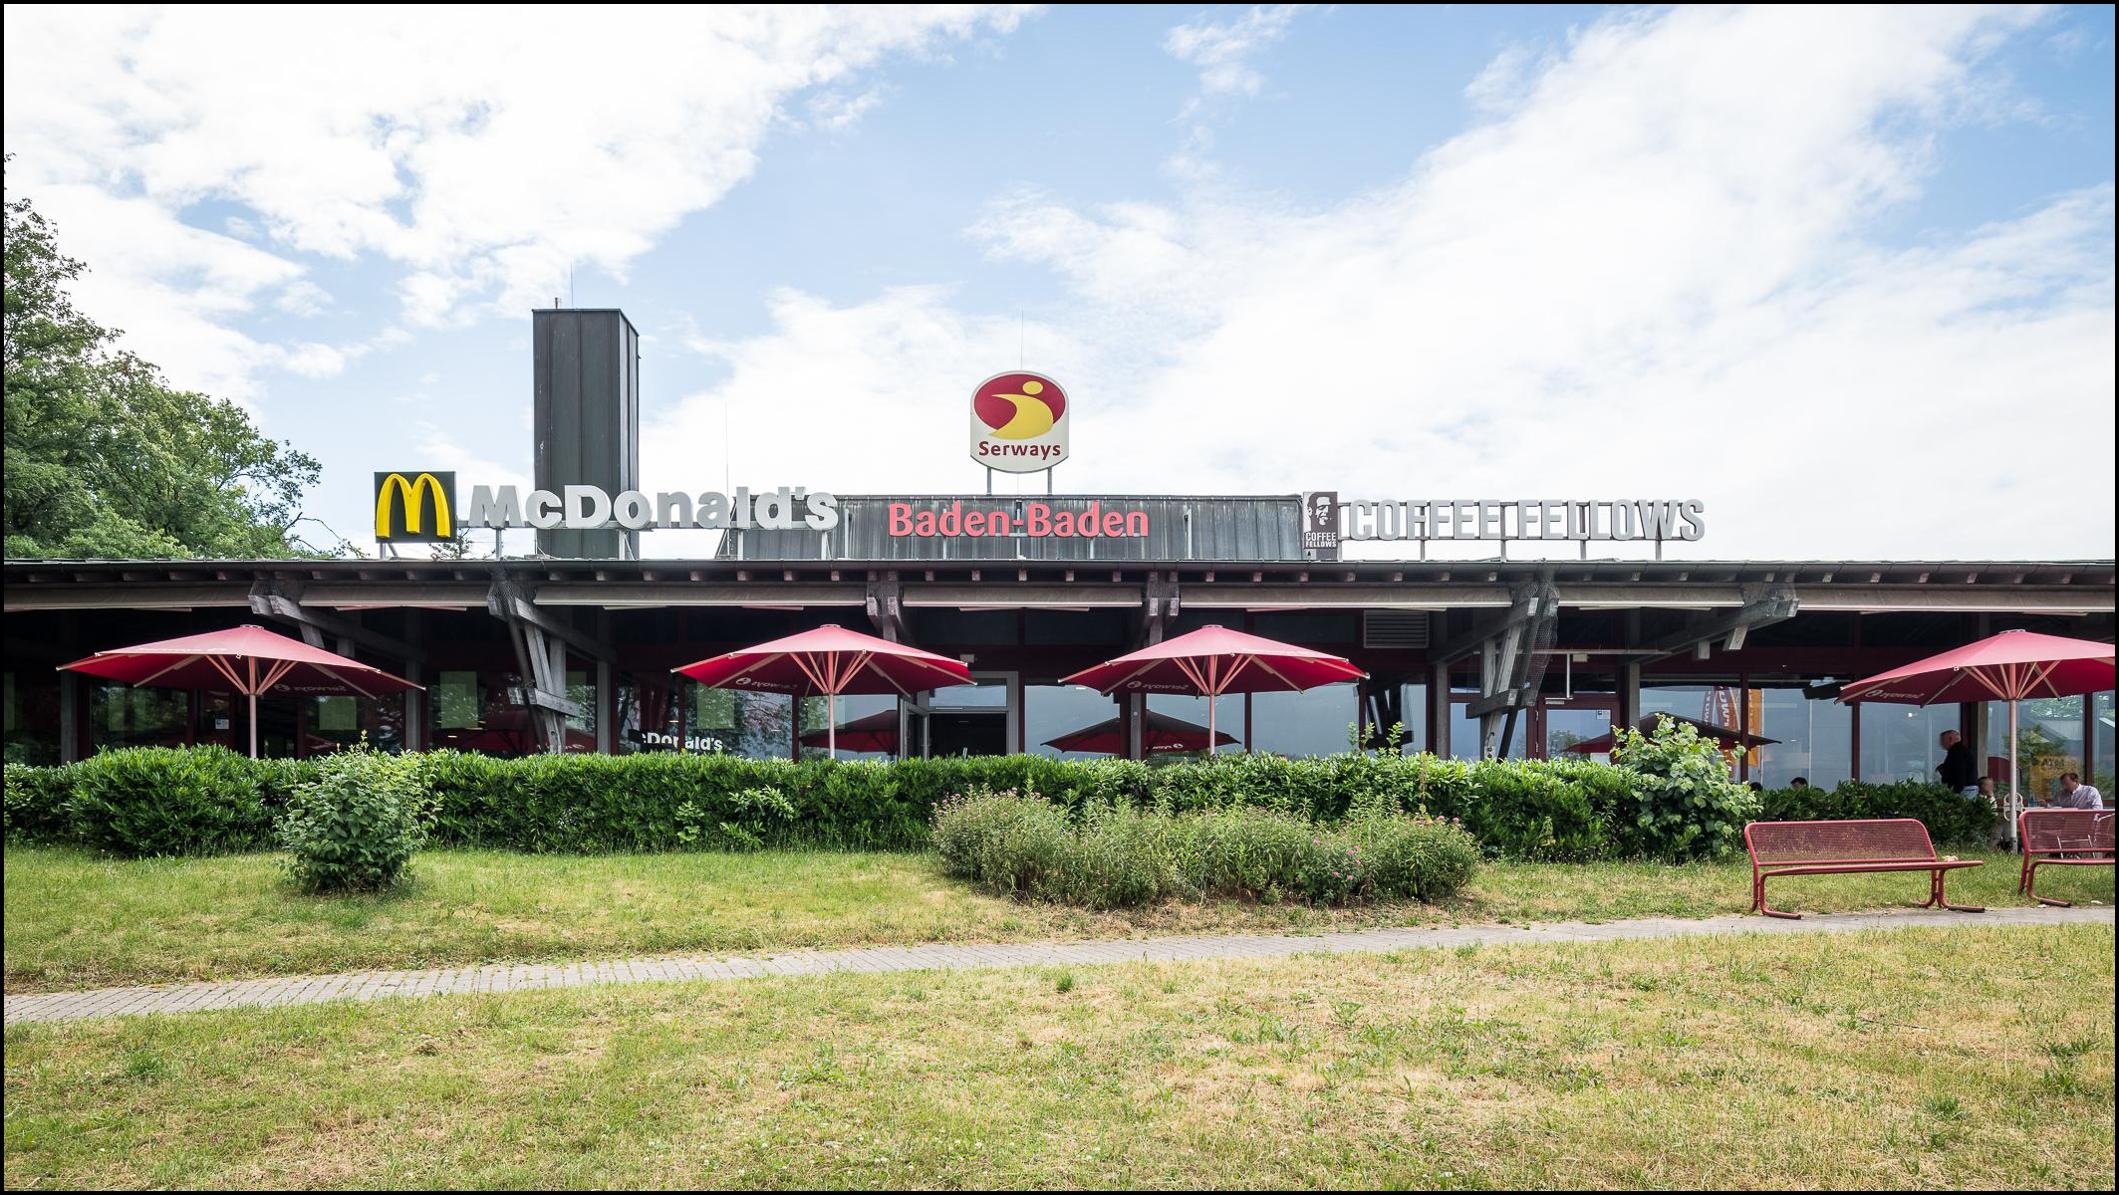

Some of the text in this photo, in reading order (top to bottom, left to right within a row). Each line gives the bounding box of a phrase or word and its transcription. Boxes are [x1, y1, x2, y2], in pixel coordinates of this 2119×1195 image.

[978, 440, 1061, 460] Serways
[468, 484, 839, 531] McDonald's
[889, 500, 1149, 537] Baden-Baden
[1348, 499, 1706, 542] COFFEE FELLOWS
[1305, 532, 1337, 541] COFFEE
